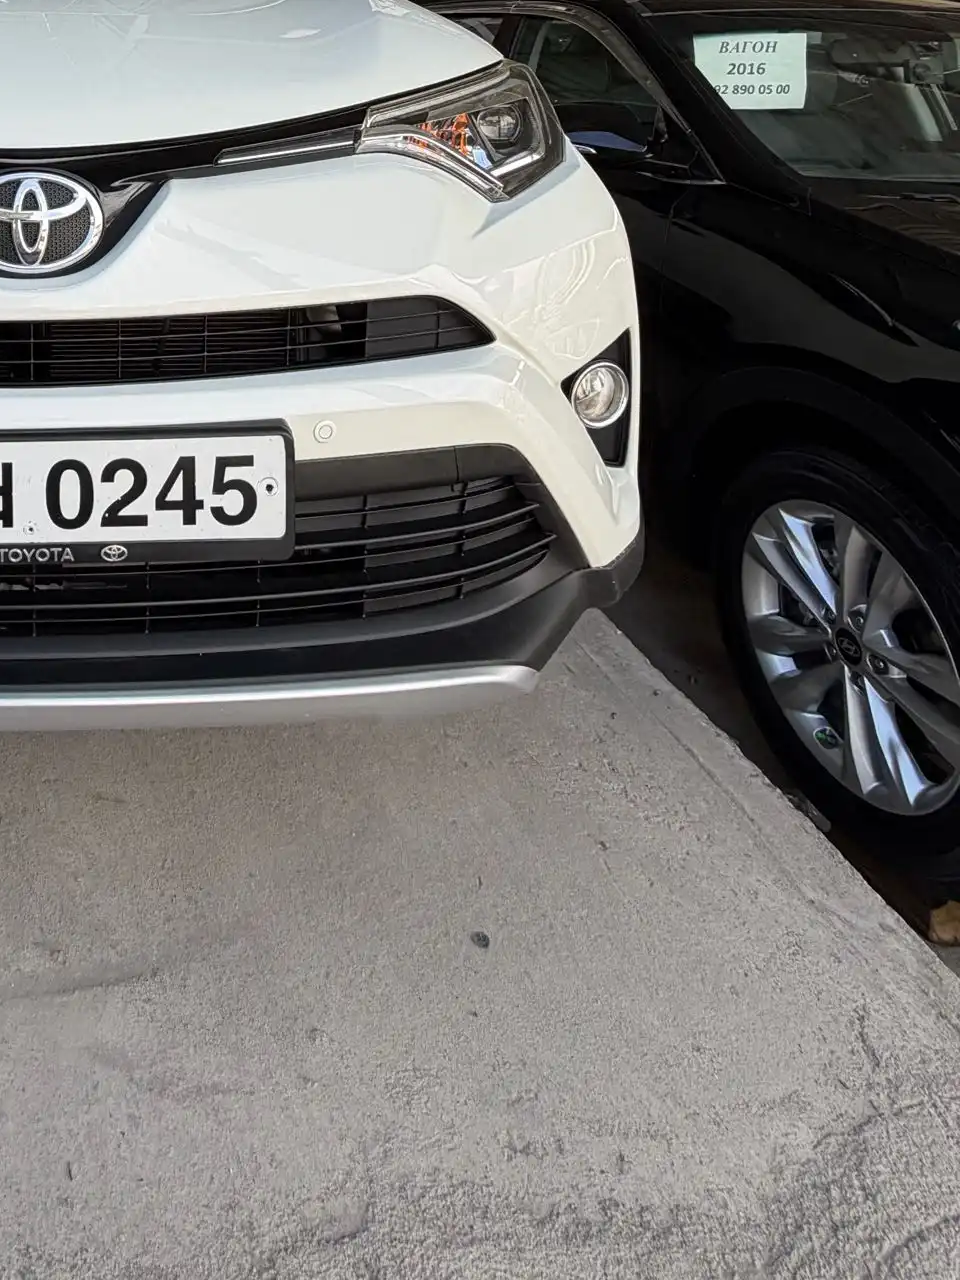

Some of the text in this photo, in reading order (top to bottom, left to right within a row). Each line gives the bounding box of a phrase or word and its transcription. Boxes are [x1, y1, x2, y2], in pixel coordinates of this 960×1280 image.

[718, 40, 778, 54] ВАГОН
[726, 62, 767, 75] 2016
[732, 84, 755, 95] 890
[758, 84, 773, 95] 05
[776, 84, 790, 95] 00
[45, 454, 259, 530] 0245
